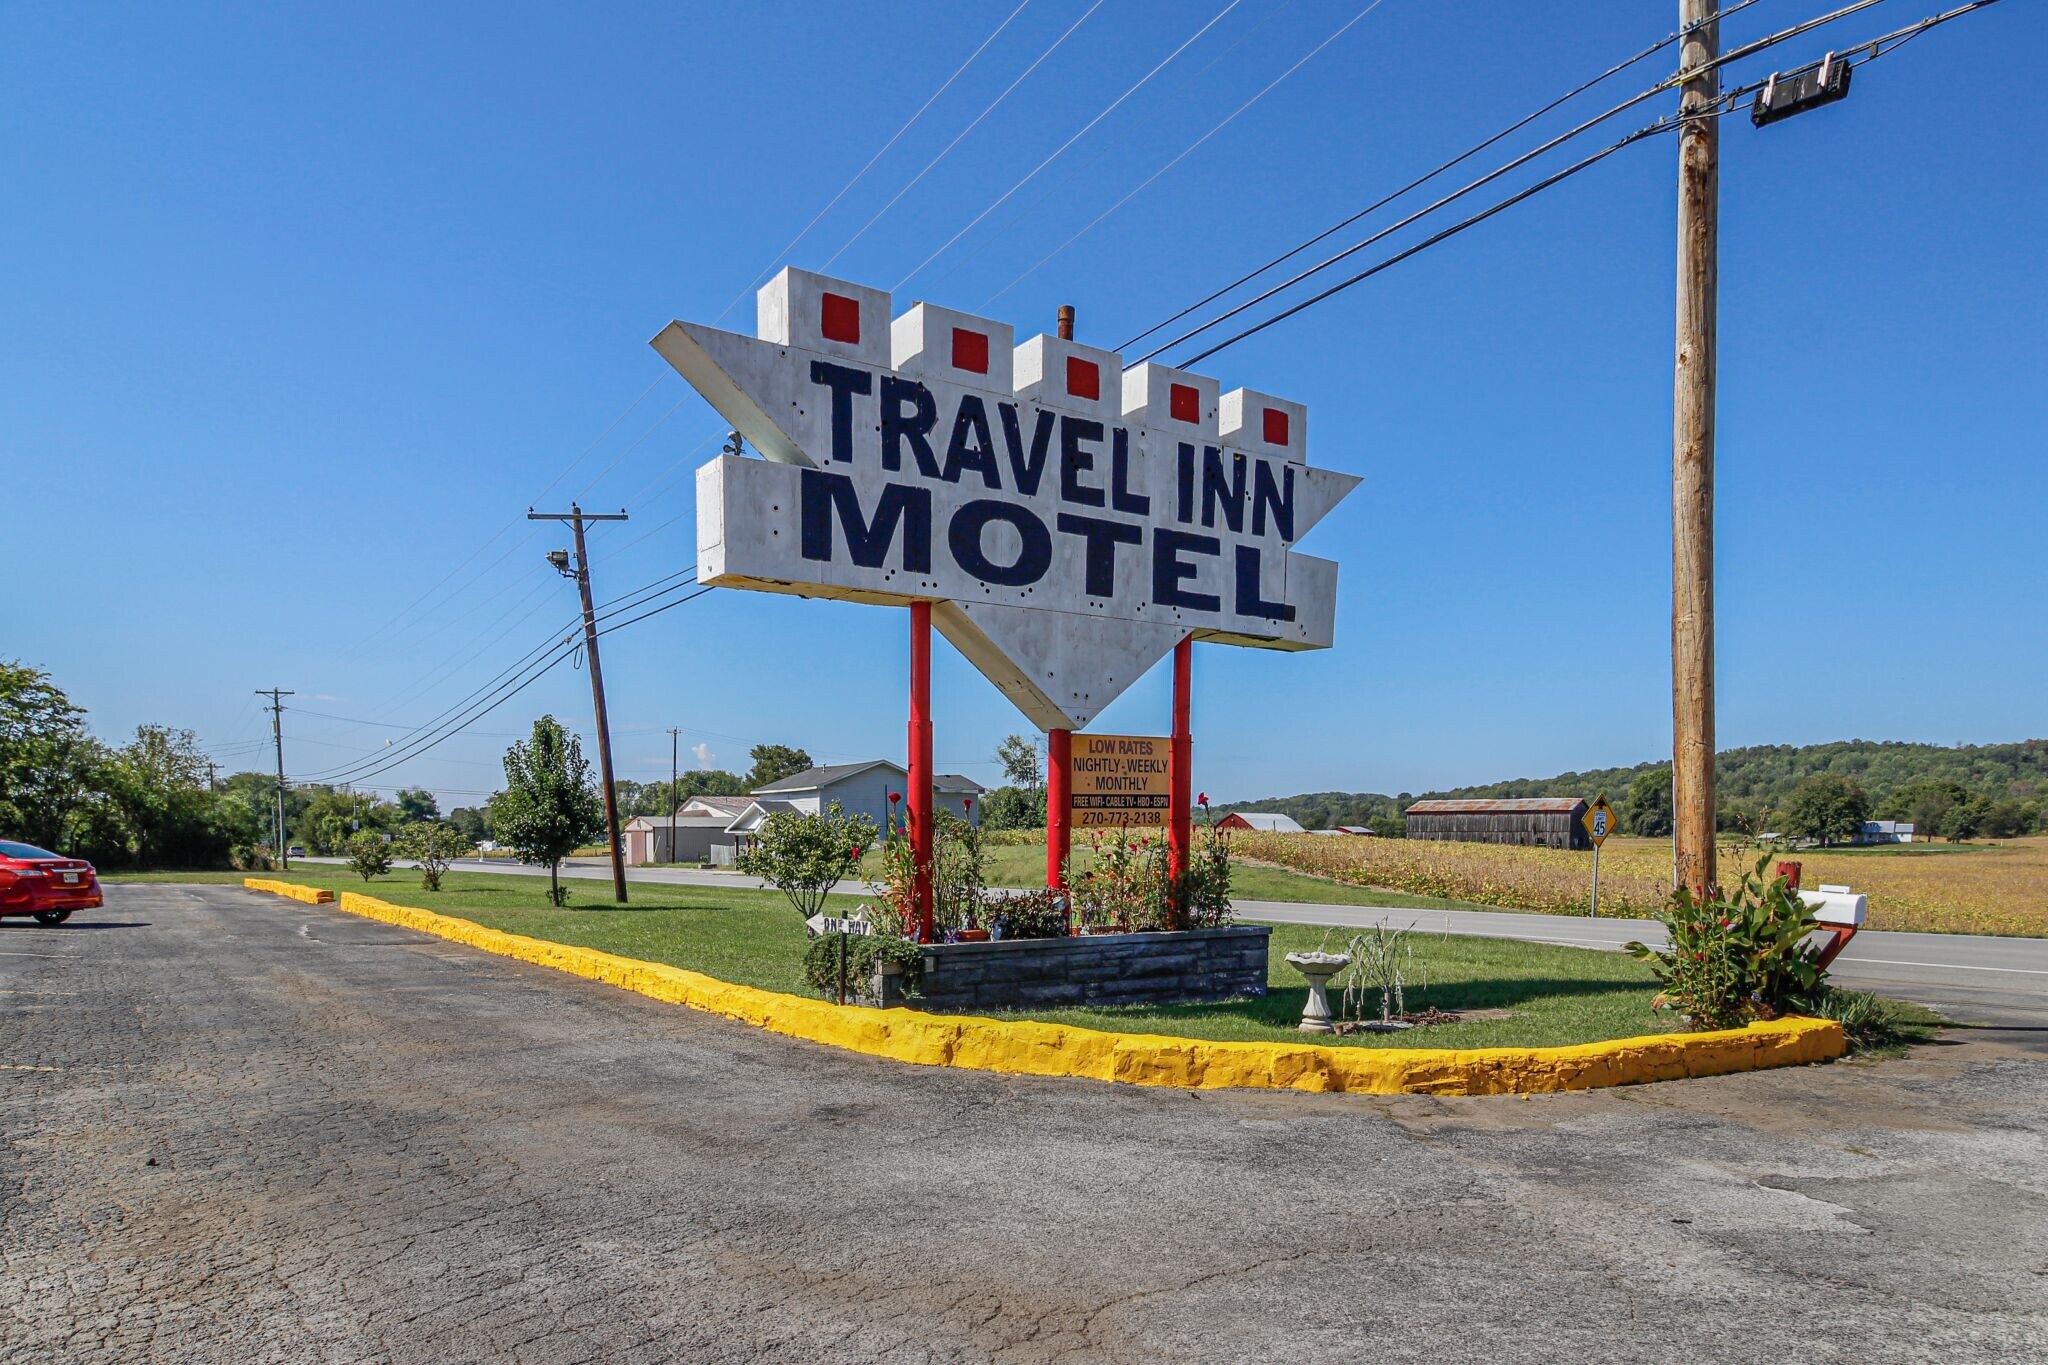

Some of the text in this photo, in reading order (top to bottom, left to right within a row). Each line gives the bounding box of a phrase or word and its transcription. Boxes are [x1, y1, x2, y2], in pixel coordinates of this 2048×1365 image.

[810, 359, 1294, 542] TRAVEL INN
[801, 469, 1297, 622] MOTEL
[1089, 739, 1153, 755] LOW RATES
[1095, 776, 1148, 790] MONTHLY
[1073, 796, 1089, 807] FREE
[1105, 796, 1125, 807] CABLE
[1153, 797, 1169, 807] ESPN
[1082, 812, 1161, 825] 270-773-2138
[1594, 821, 1605, 835] 45
[848, 920, 868, 935] WAY
